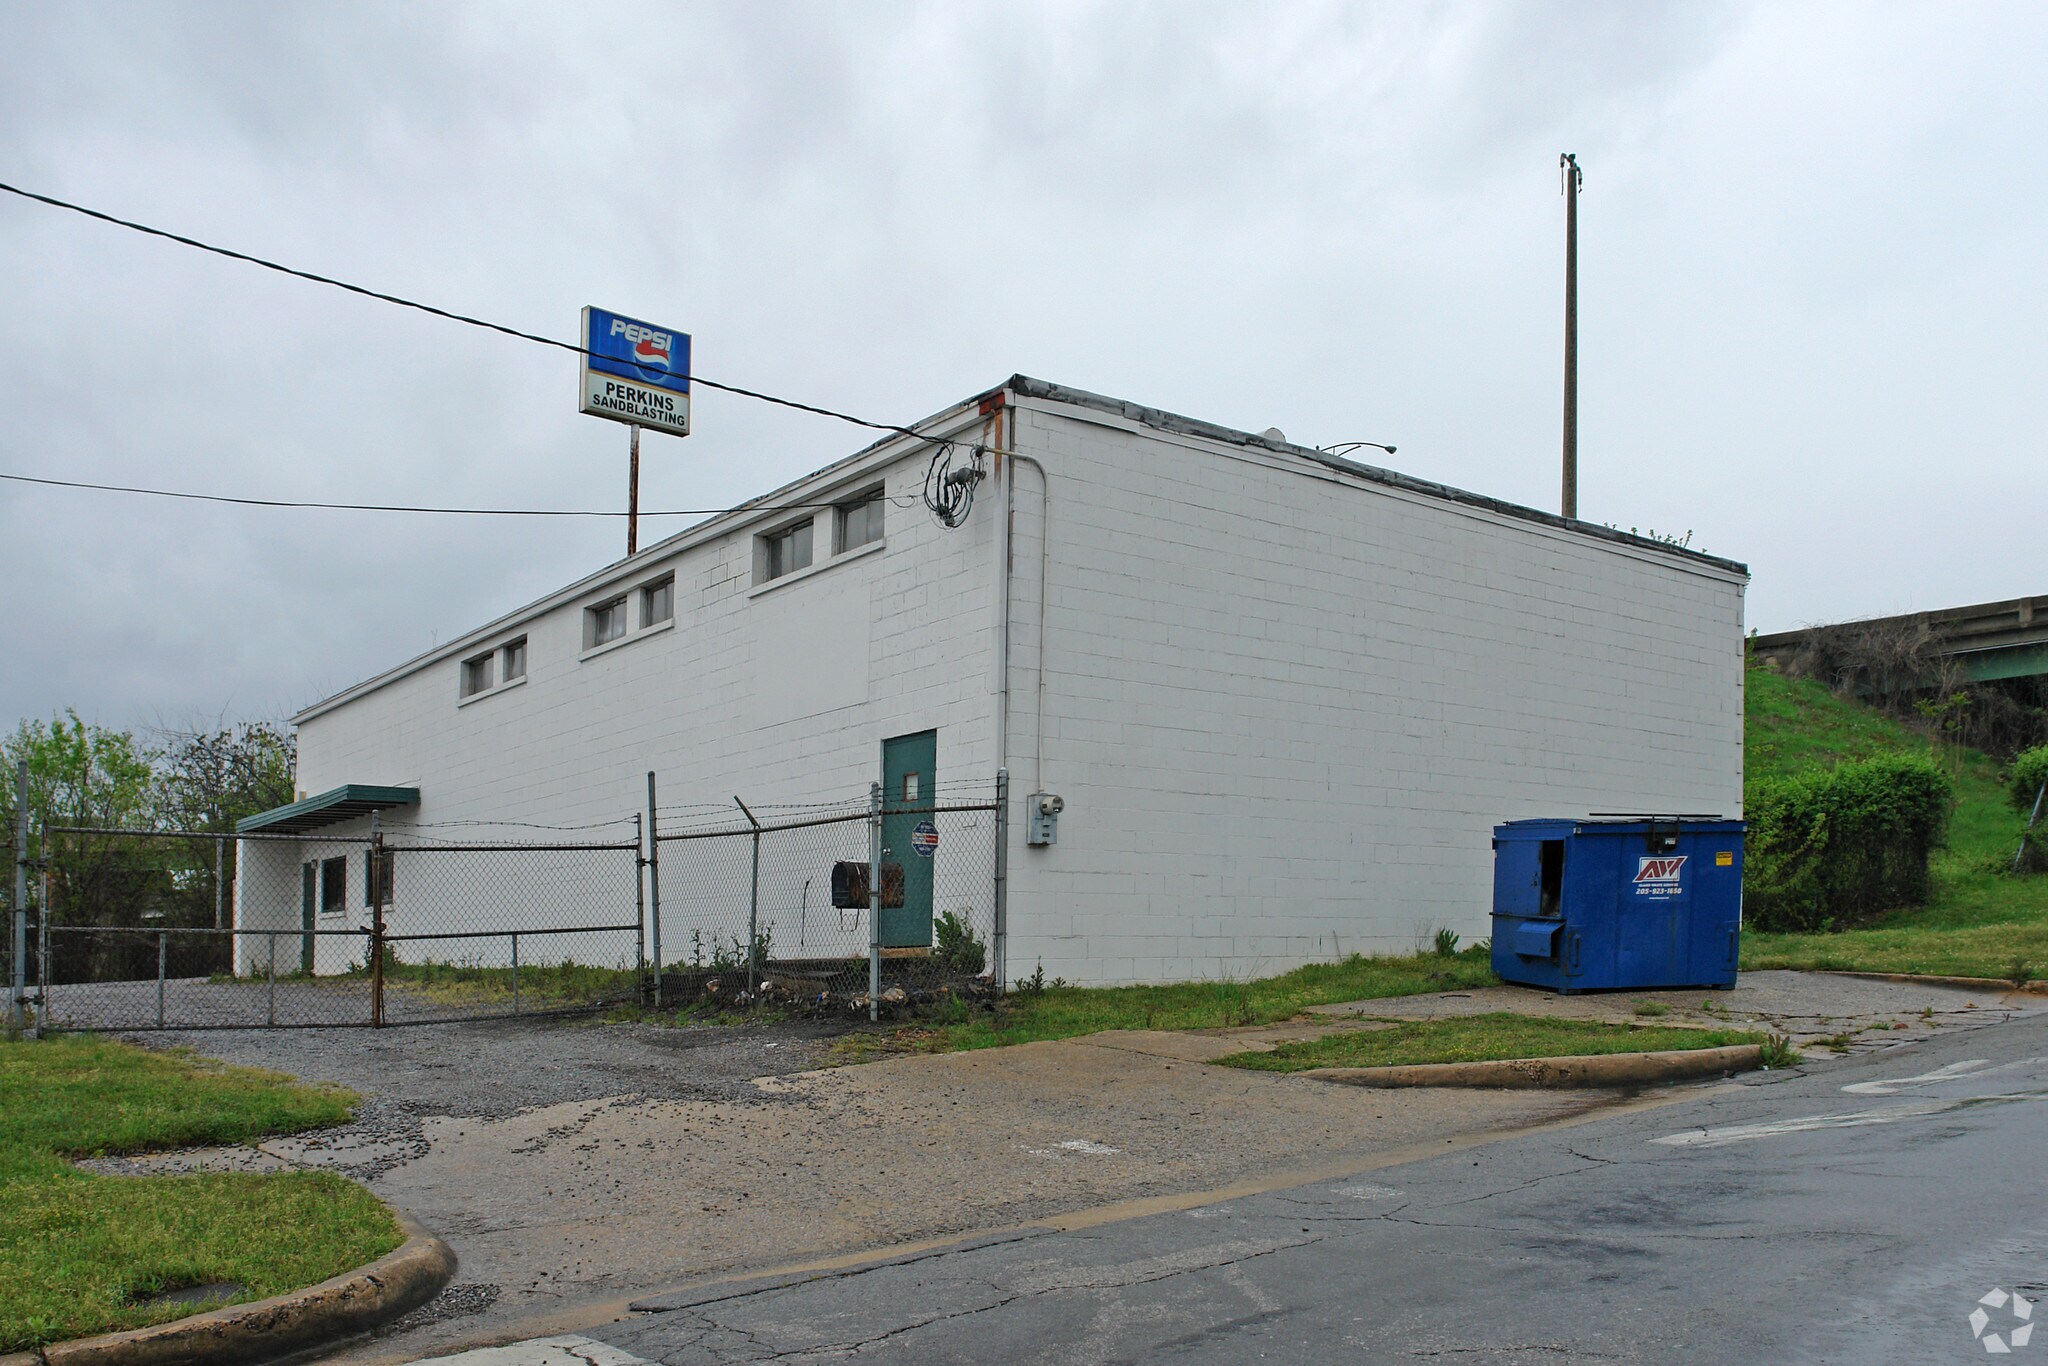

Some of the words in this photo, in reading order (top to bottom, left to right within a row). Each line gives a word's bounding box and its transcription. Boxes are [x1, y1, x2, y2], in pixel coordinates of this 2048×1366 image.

[610, 319, 672, 352] PEPSI
[593, 394, 685, 426] SANDBLASTING
[606, 382, 674, 411] PERKINS
